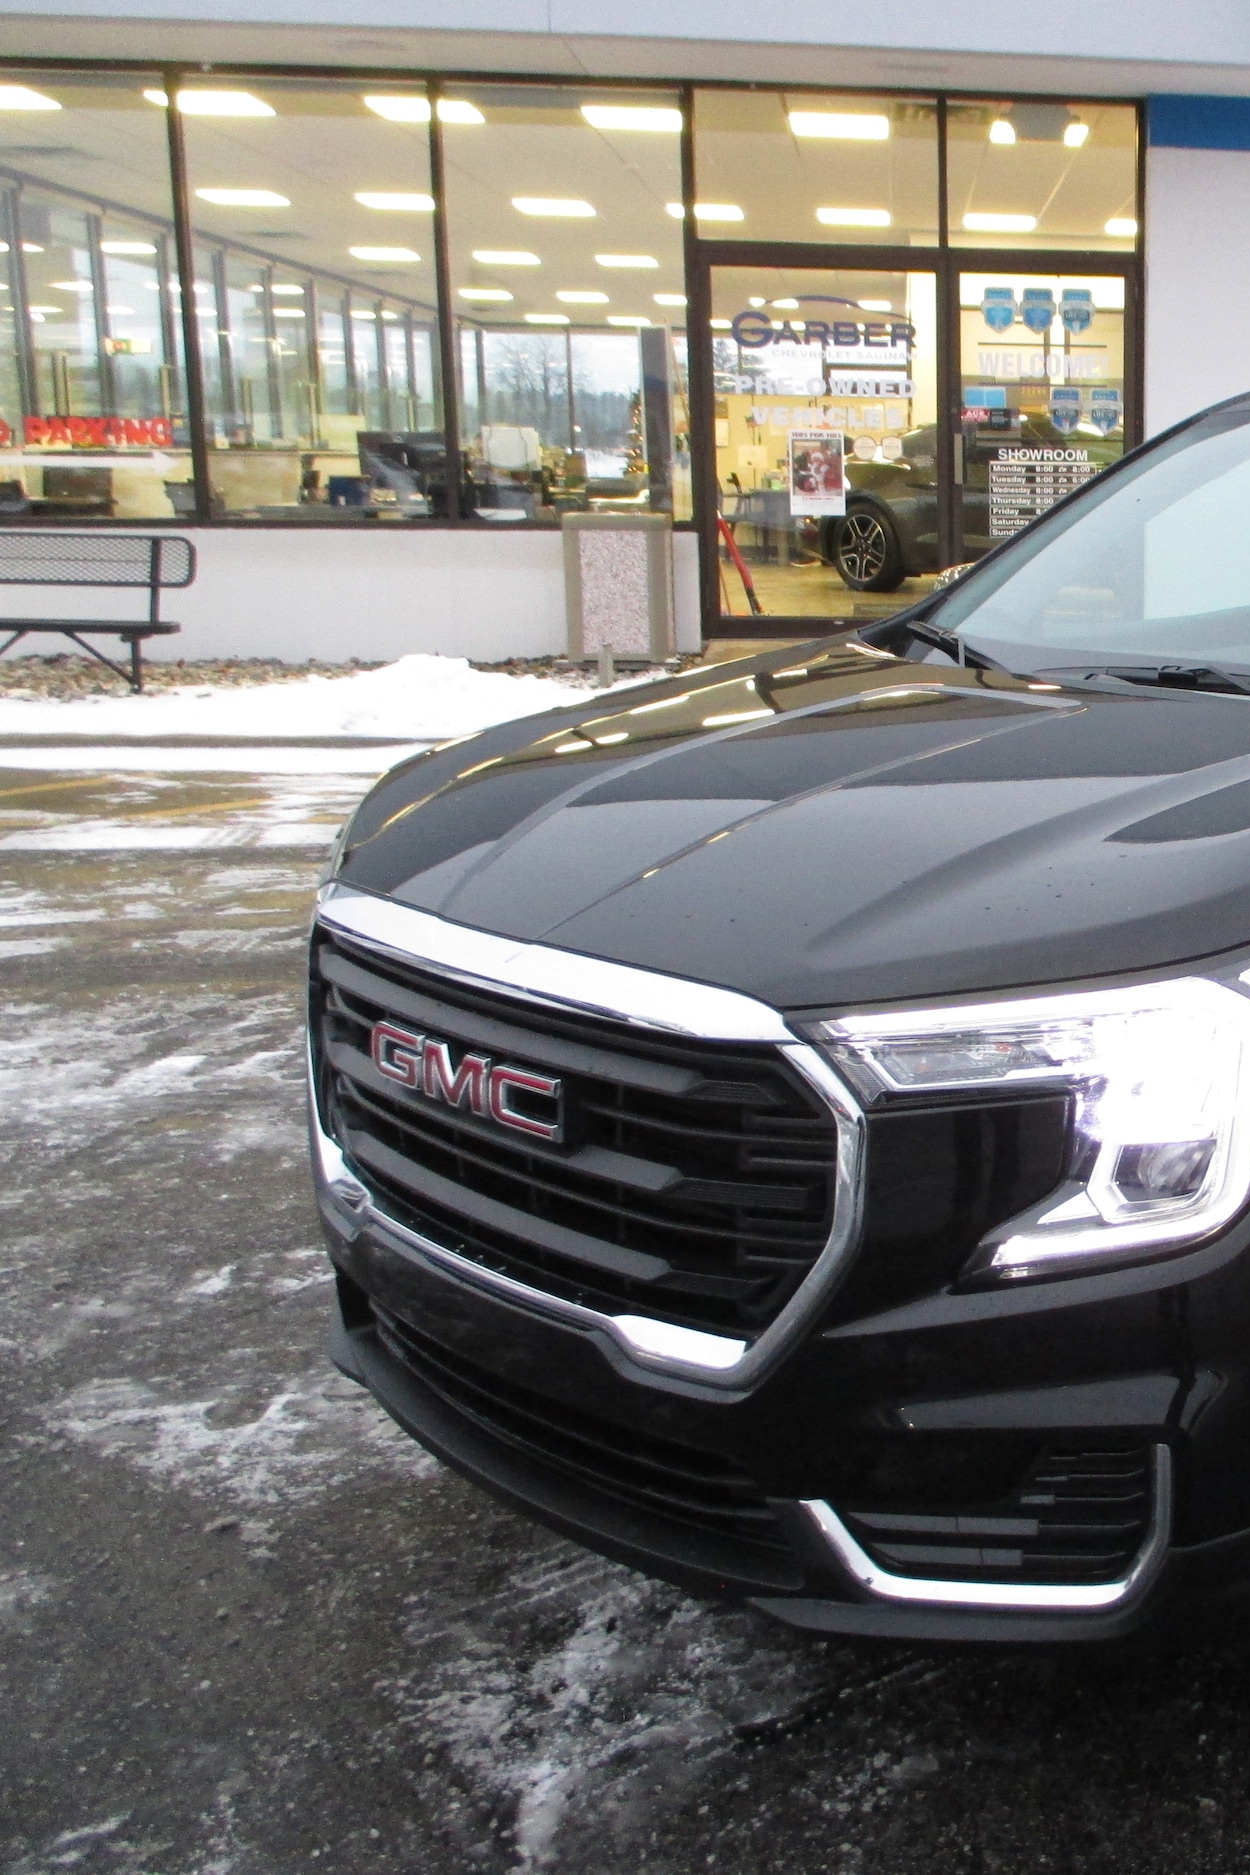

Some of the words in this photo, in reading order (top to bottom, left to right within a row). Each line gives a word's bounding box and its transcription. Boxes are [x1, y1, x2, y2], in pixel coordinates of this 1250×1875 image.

[731, 311, 917, 348] GARBER
[772, 349, 855, 360] CHEVROLET
[857, 350, 918, 361] SAGINAW
[978, 352, 1110, 378] WELCOME!
[735, 375, 917, 398] PRE-OWNED
[751, 405, 904, 429] VEHICLES
[23, 416, 174, 446] PARKING
[998, 448, 1088, 461] SHOWROOM
[992, 465, 1026, 473] Monday
[992, 476, 1026, 484] Tuesday
[992, 487, 1031, 495] Wednesday
[992, 497, 1031, 506] Thursday
[992, 508, 1019, 516] Friday
[991, 529, 1019, 537] Sund
[371, 1018, 564, 1143] GMC
